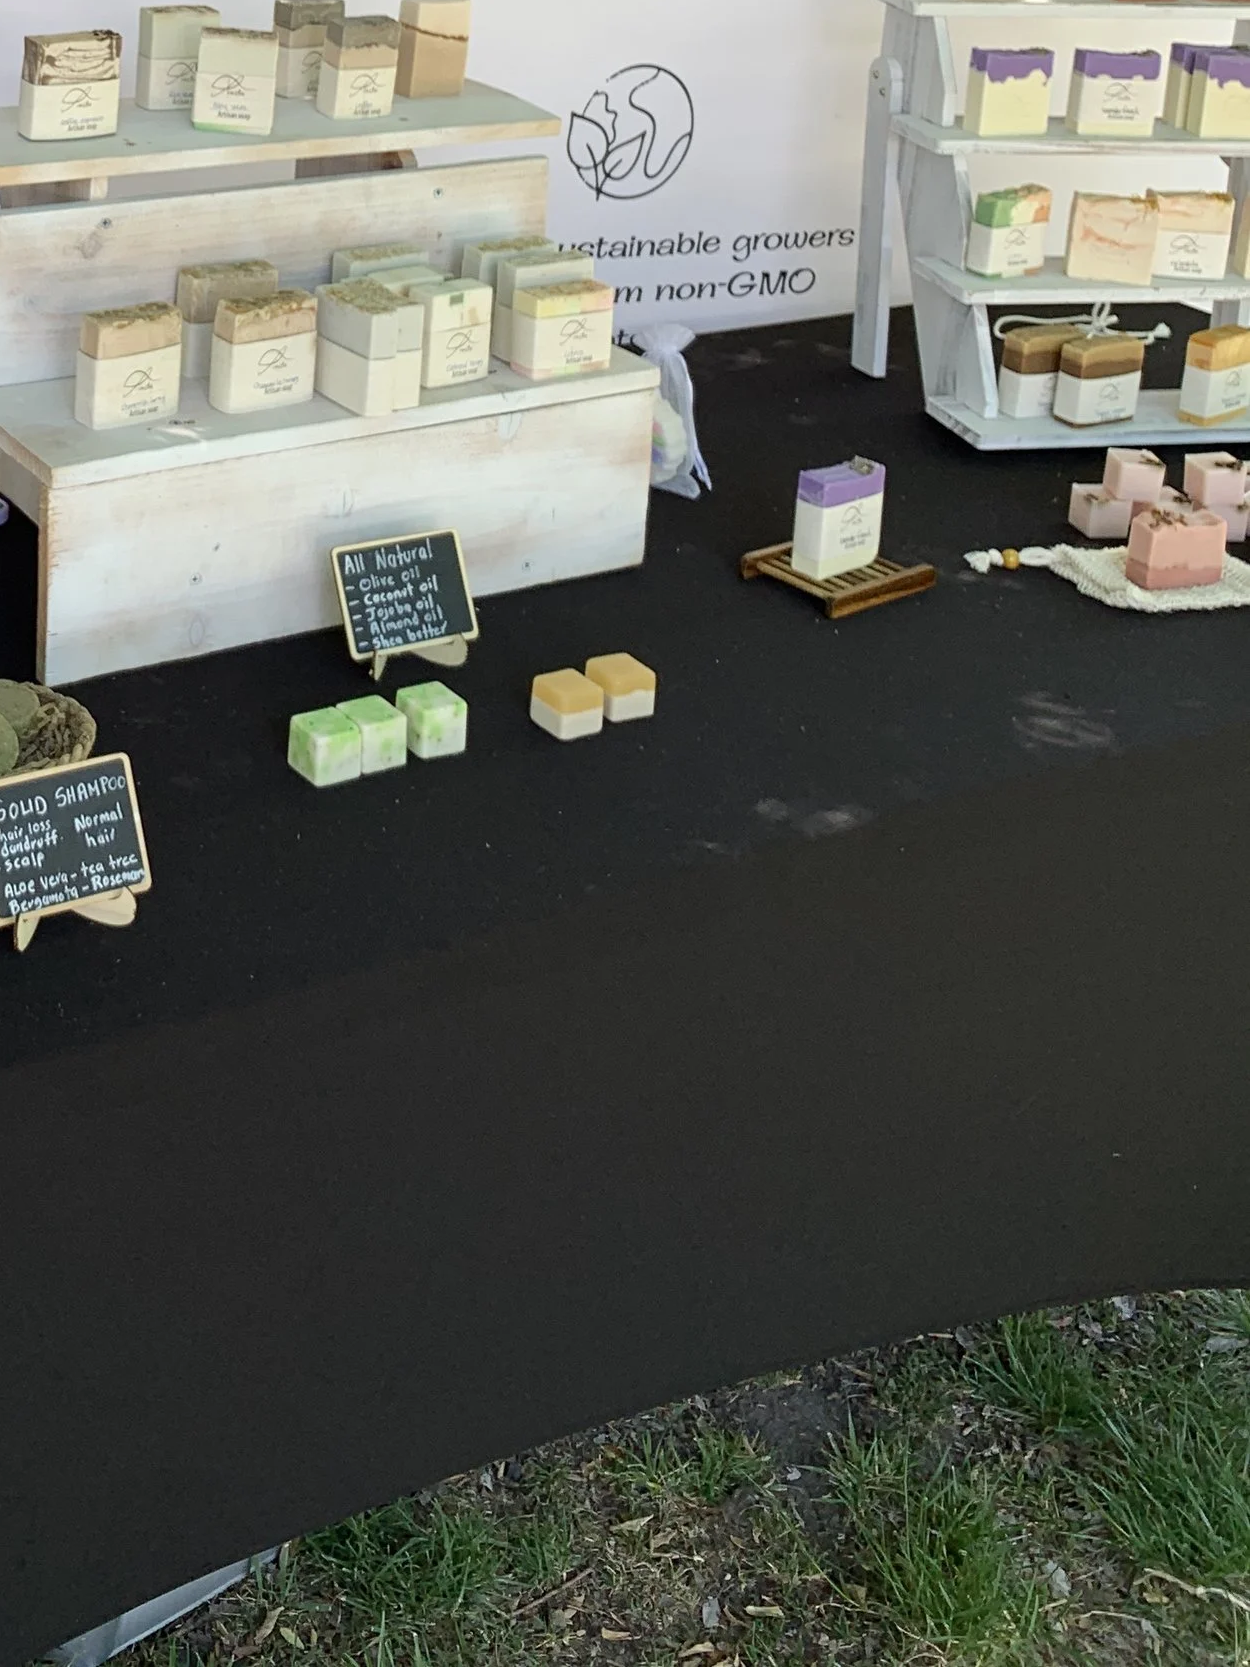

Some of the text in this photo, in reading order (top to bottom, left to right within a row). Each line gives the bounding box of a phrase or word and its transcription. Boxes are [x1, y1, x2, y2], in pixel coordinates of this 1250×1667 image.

[732, 227, 855, 263] growers
[655, 267, 816, 302] non-GMO
[344, 537, 433, 575] All Natural
[419, 574, 438, 592] oil
[415, 593, 434, 610] oil
[370, 611, 419, 635] Almond
[424, 604, 443, 621] oil
[54, 775, 126, 808] SHAMPOO
[28, 819, 51, 835] loss
[74, 801, 123, 833] Normal
[85, 828, 116, 848] hair
[5, 851, 45, 873] scalp
[81, 861, 104, 877] tea
[108, 853, 138, 870] tree
